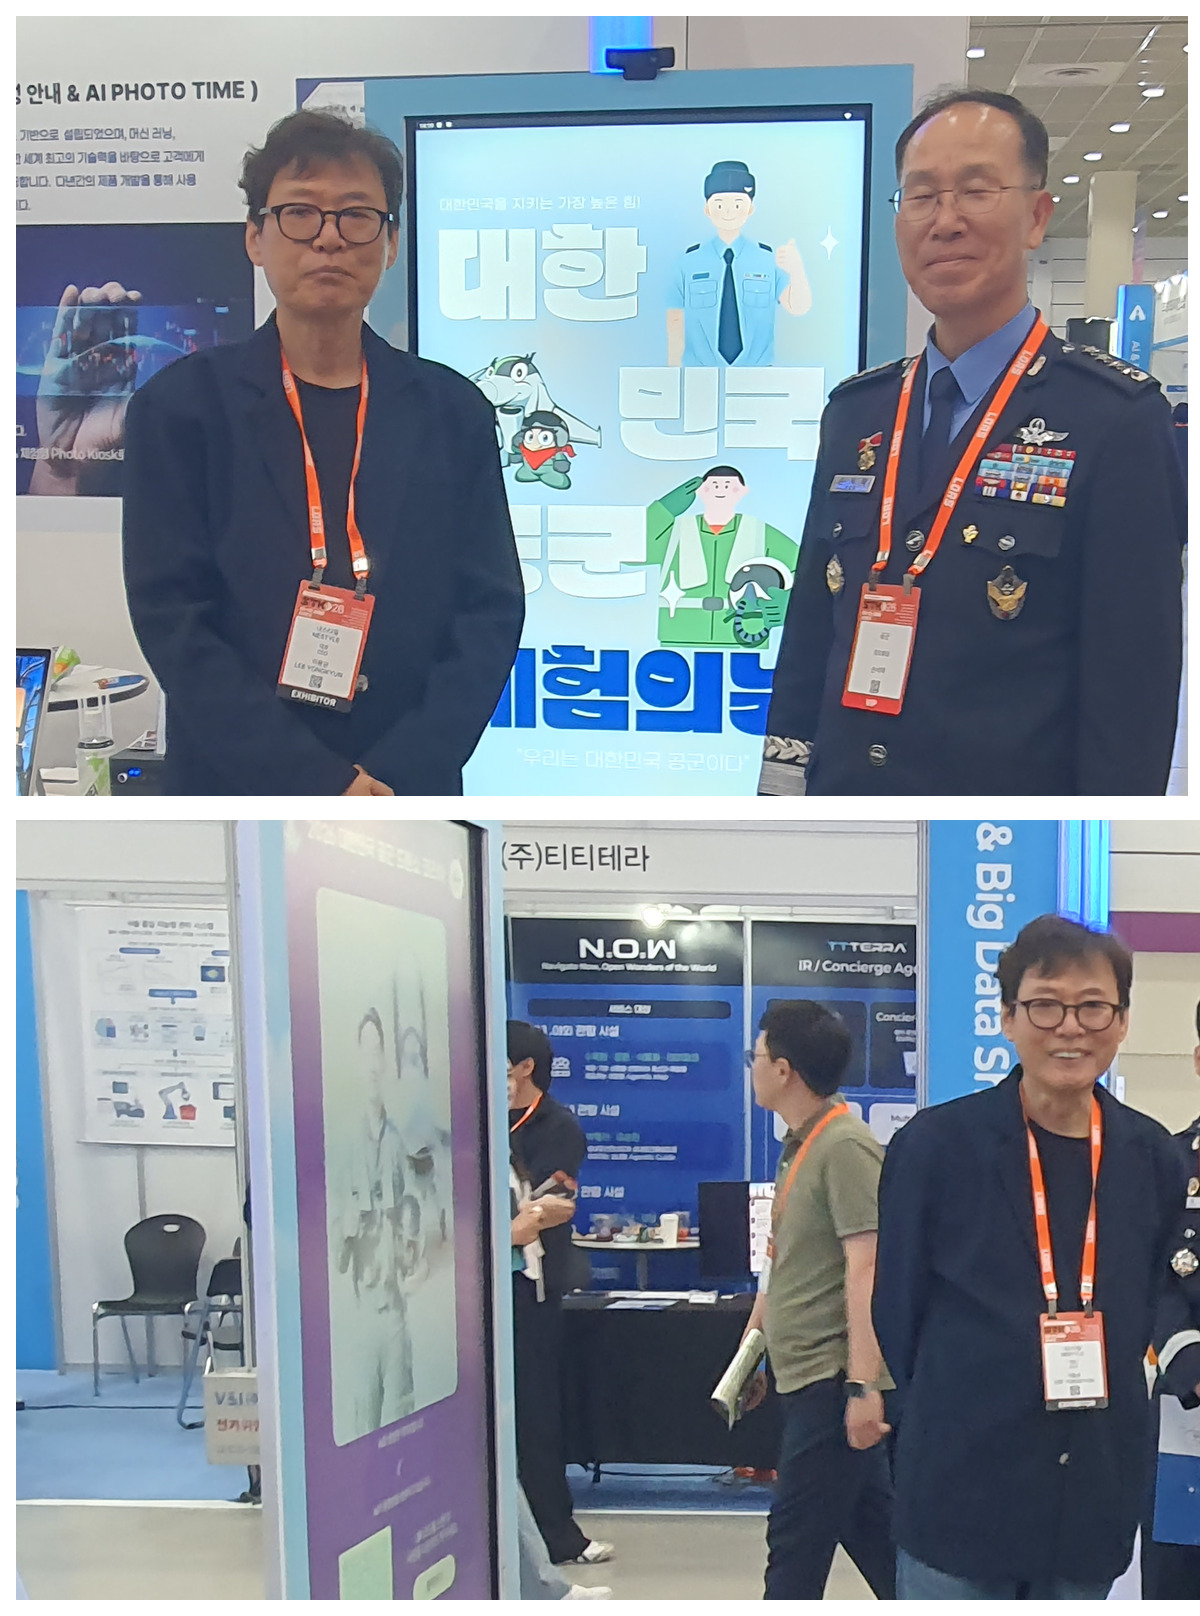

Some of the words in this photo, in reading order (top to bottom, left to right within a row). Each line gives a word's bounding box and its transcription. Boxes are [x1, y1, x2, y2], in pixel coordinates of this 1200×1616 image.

[26, 83, 61, 104] 안내
[66, 84, 80, 102] &
[85, 83, 106, 102] AI
[111, 81, 186, 101] PHOTO
[191, 80, 245, 100] TIME
[250, 80, 258, 102] )
[20, 129, 59, 141] 기반으로
[439, 195, 508, 213] 대한민국을
[511, 195, 553, 211] 지키는
[558, 194, 586, 211] 가장
[591, 194, 619, 211] 높은
[623, 194, 642, 210] 힘!
[438, 223, 648, 322] 대한
[1011, 350, 1033, 376] LORS
[619, 366, 826, 462] 민국
[977, 411, 998, 439] LORS
[51, 447, 86, 460] Photo
[943, 477, 965, 509] LORS
[291, 689, 337, 707] EXHIBITOR
[585, 750, 661, 771] 대한민국
[975, 822, 1013, 852] &
[501, 841, 650, 872] (주)티티테라
[966, 863, 1016, 930] Big
[578, 938, 676, 960] N.O.W
[690, 964, 717, 973] World
[798, 960, 812, 972] IR
[813, 961, 820, 973] /
[822, 960, 891, 977] Concierge
[973, 941, 1011, 1036] Data
[973, 1046, 1010, 1092] Sh
